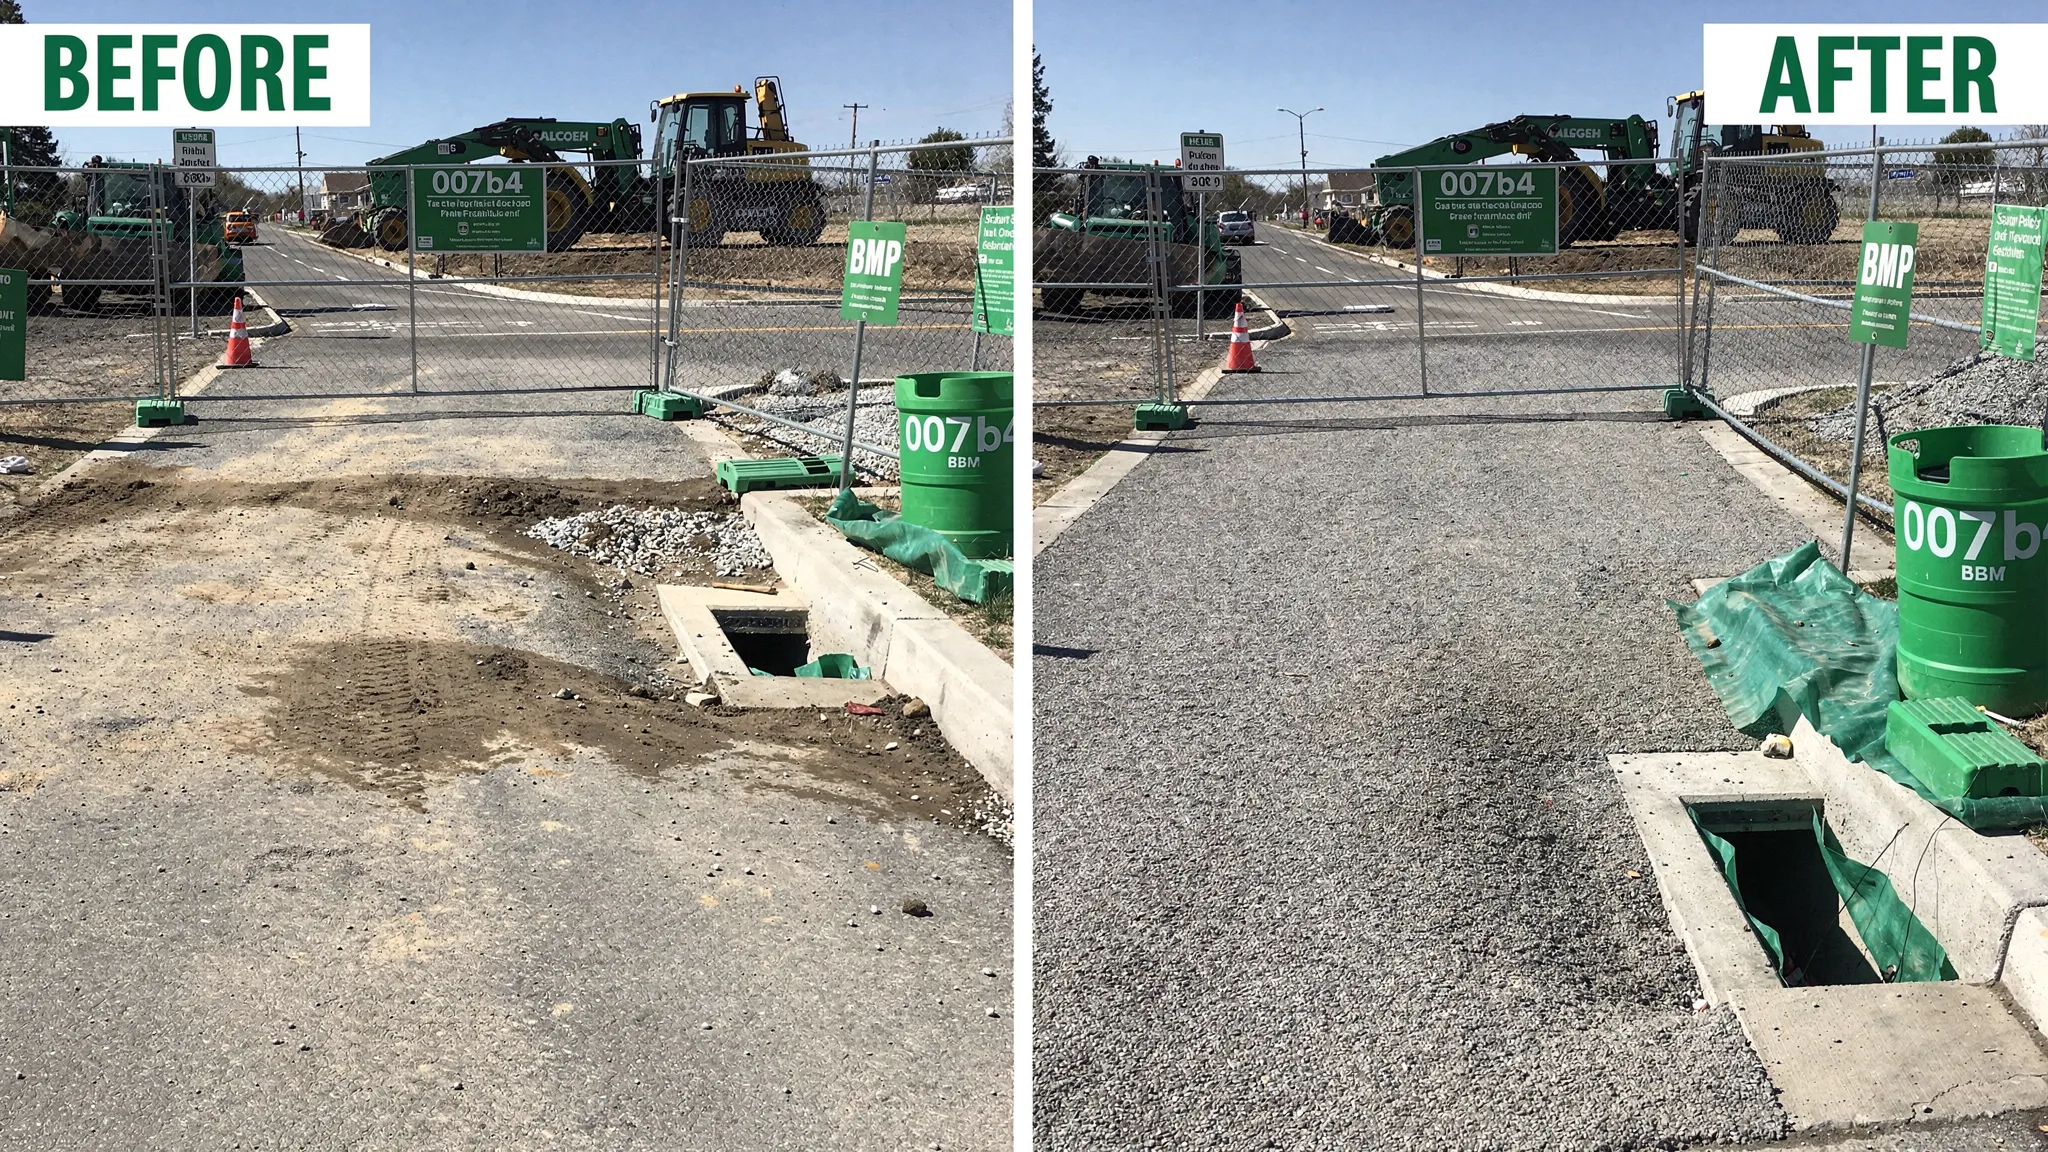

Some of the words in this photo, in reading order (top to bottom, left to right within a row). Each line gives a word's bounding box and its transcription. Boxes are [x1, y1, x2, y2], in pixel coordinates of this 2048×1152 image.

[432, 170, 524, 194] 007b4
[1440, 171, 1536, 196] 007b4
[849, 238, 902, 277] BMP
[1861, 242, 1914, 289] BMP
[947, 456, 980, 468] BBM
[1904, 501, 2048, 561] 007b
[1961, 565, 2006, 581] BBM
